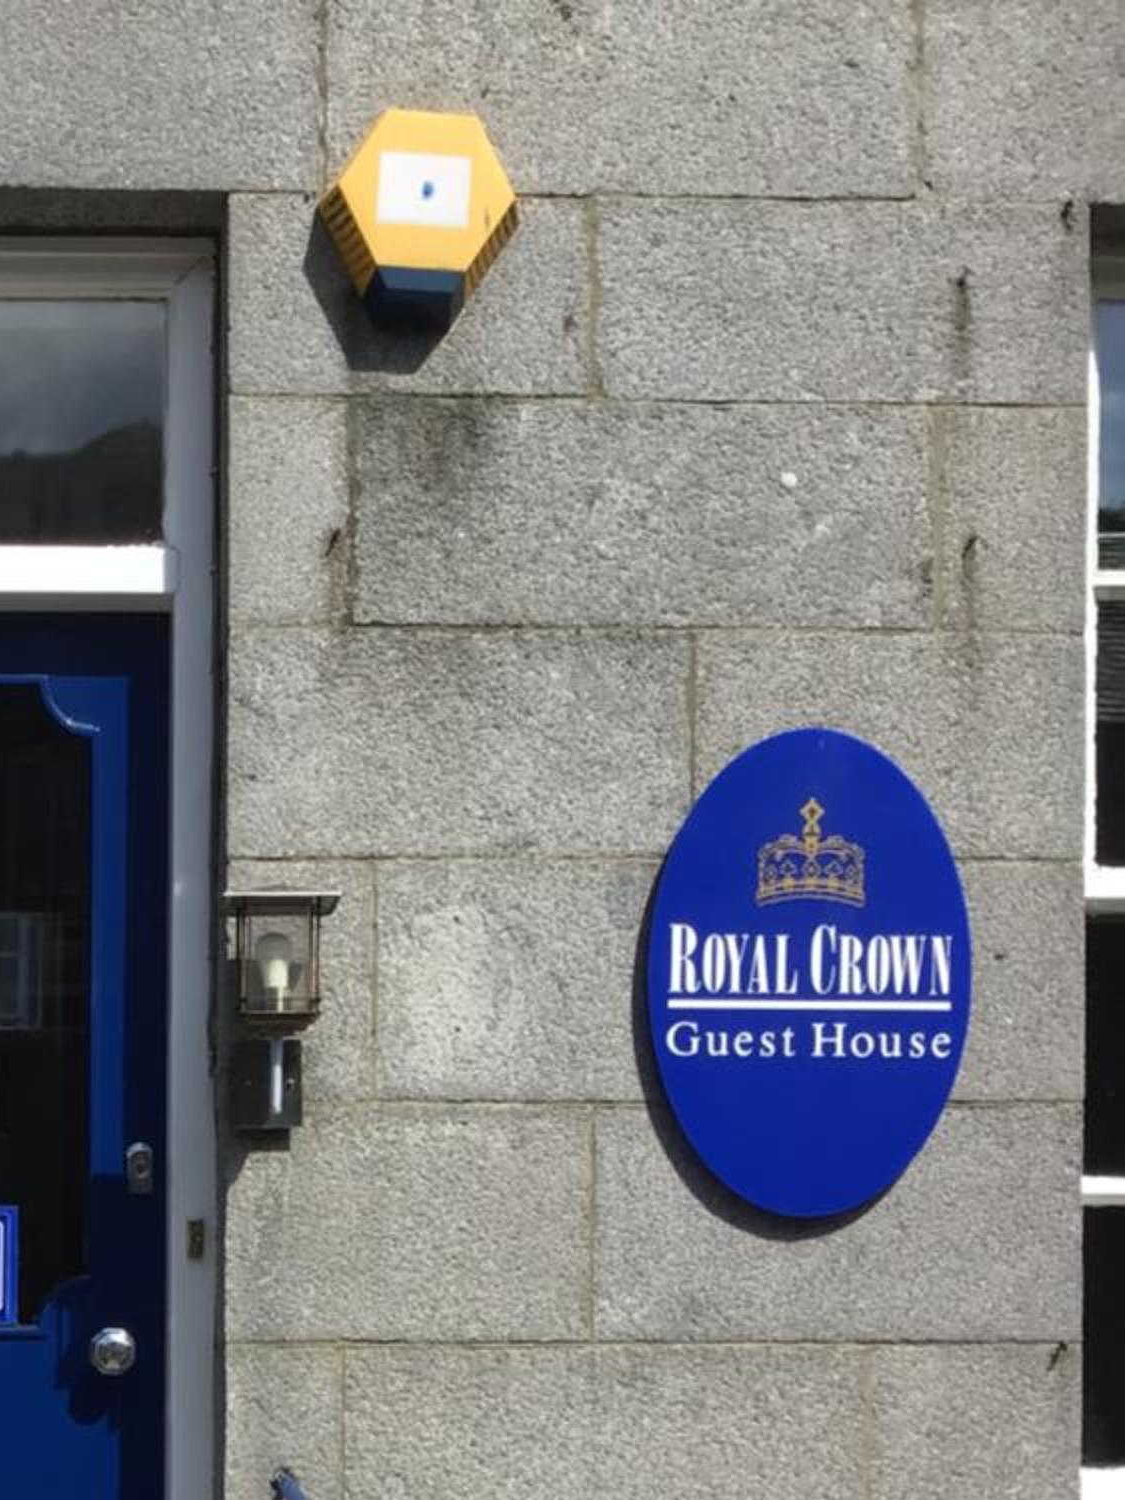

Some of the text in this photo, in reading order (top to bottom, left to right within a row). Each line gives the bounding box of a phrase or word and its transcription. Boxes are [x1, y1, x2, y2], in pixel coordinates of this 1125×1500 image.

[669, 922, 953, 996] ROYAL CROWN
[666, 1021, 952, 1059] Guest House
